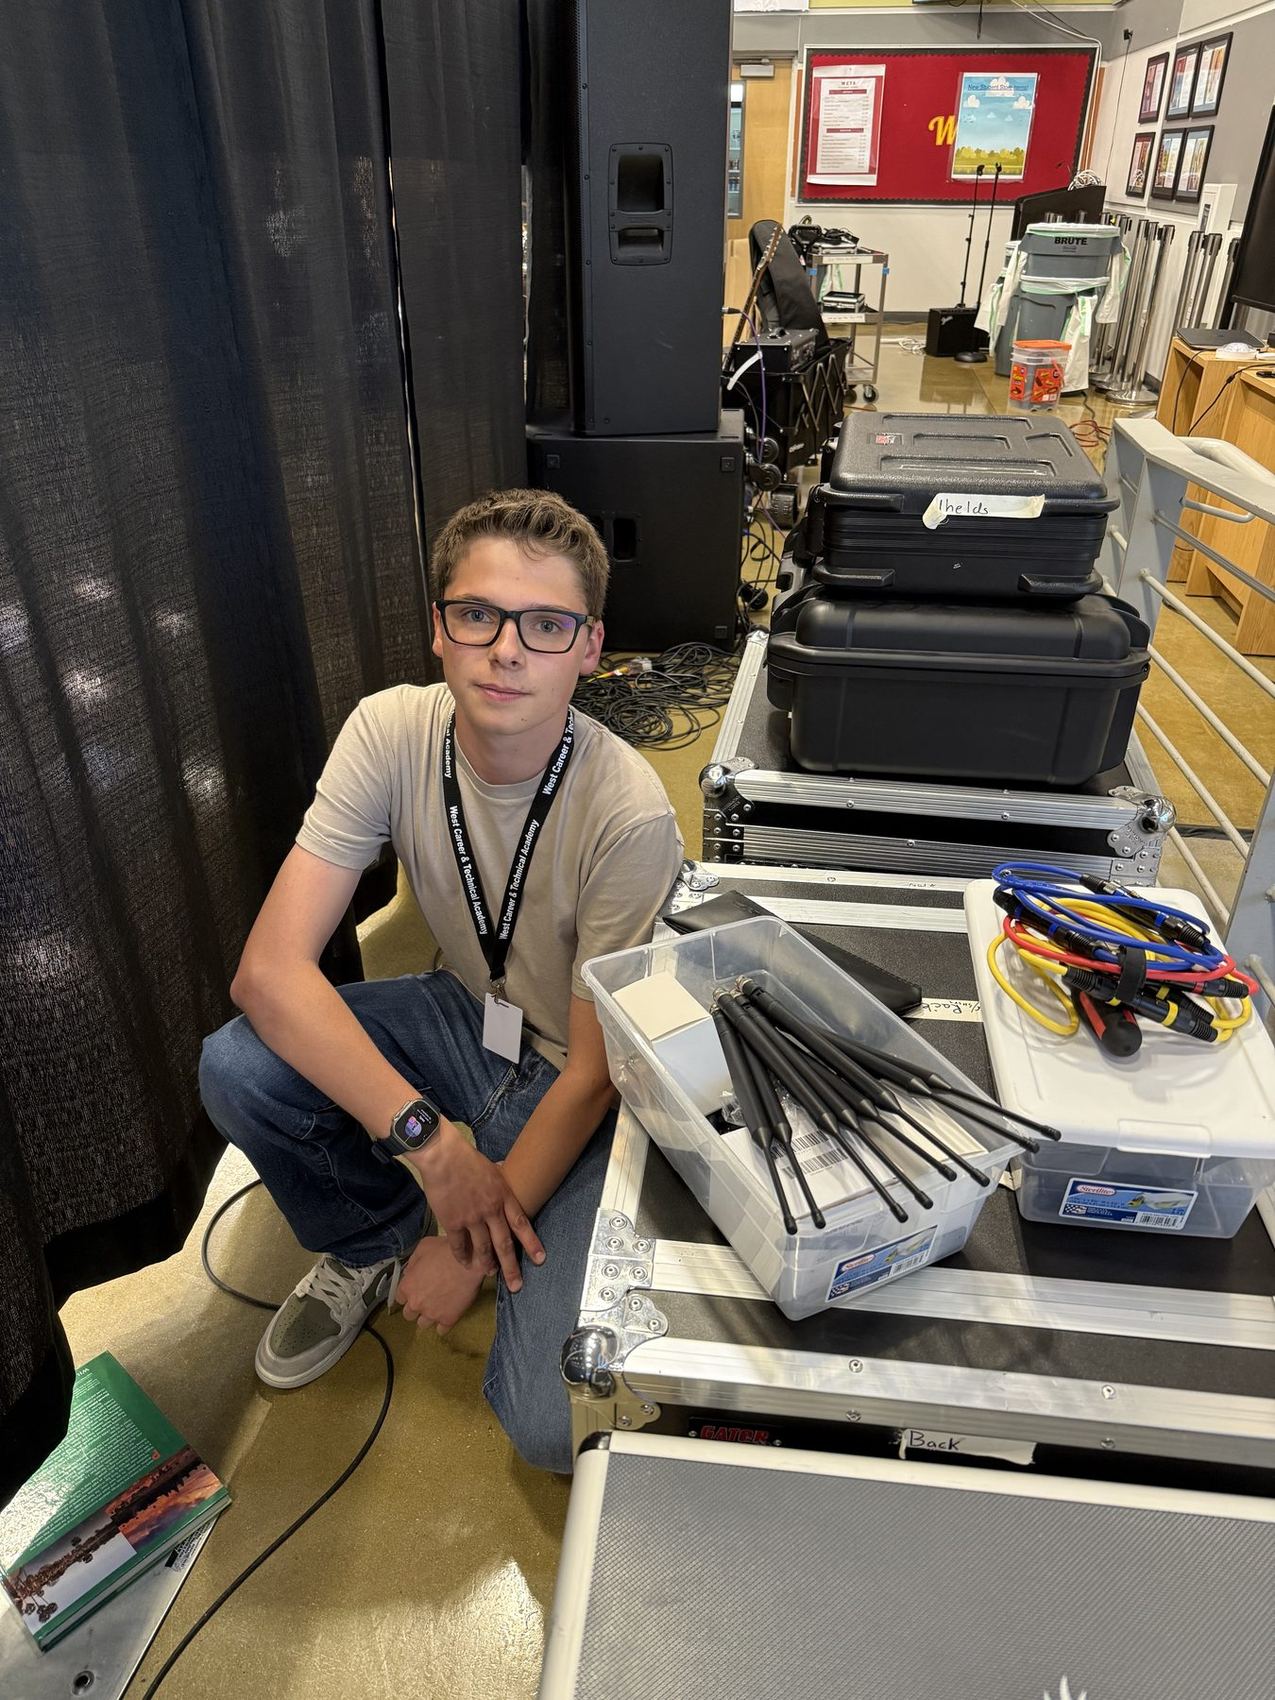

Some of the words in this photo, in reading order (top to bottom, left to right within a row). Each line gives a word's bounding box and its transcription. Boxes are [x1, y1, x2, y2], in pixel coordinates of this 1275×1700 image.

[1054, 236, 1088, 246] BRUTE
[444, 738, 452, 779] Academy
[542, 773, 558, 796] West
[552, 743, 570, 774] Career
[562, 736, 572, 744] &
[449, 805, 460, 827] West
[453, 828, 466, 856] Career
[460, 856, 470, 864] &
[503, 898, 516, 922] Career
[510, 854, 526, 891] Technical
[520, 818, 540, 856] Academy
[463, 863, 480, 901] Technical
[472, 901, 488, 935] Academy
[909, 1430, 962, 1451] Back
